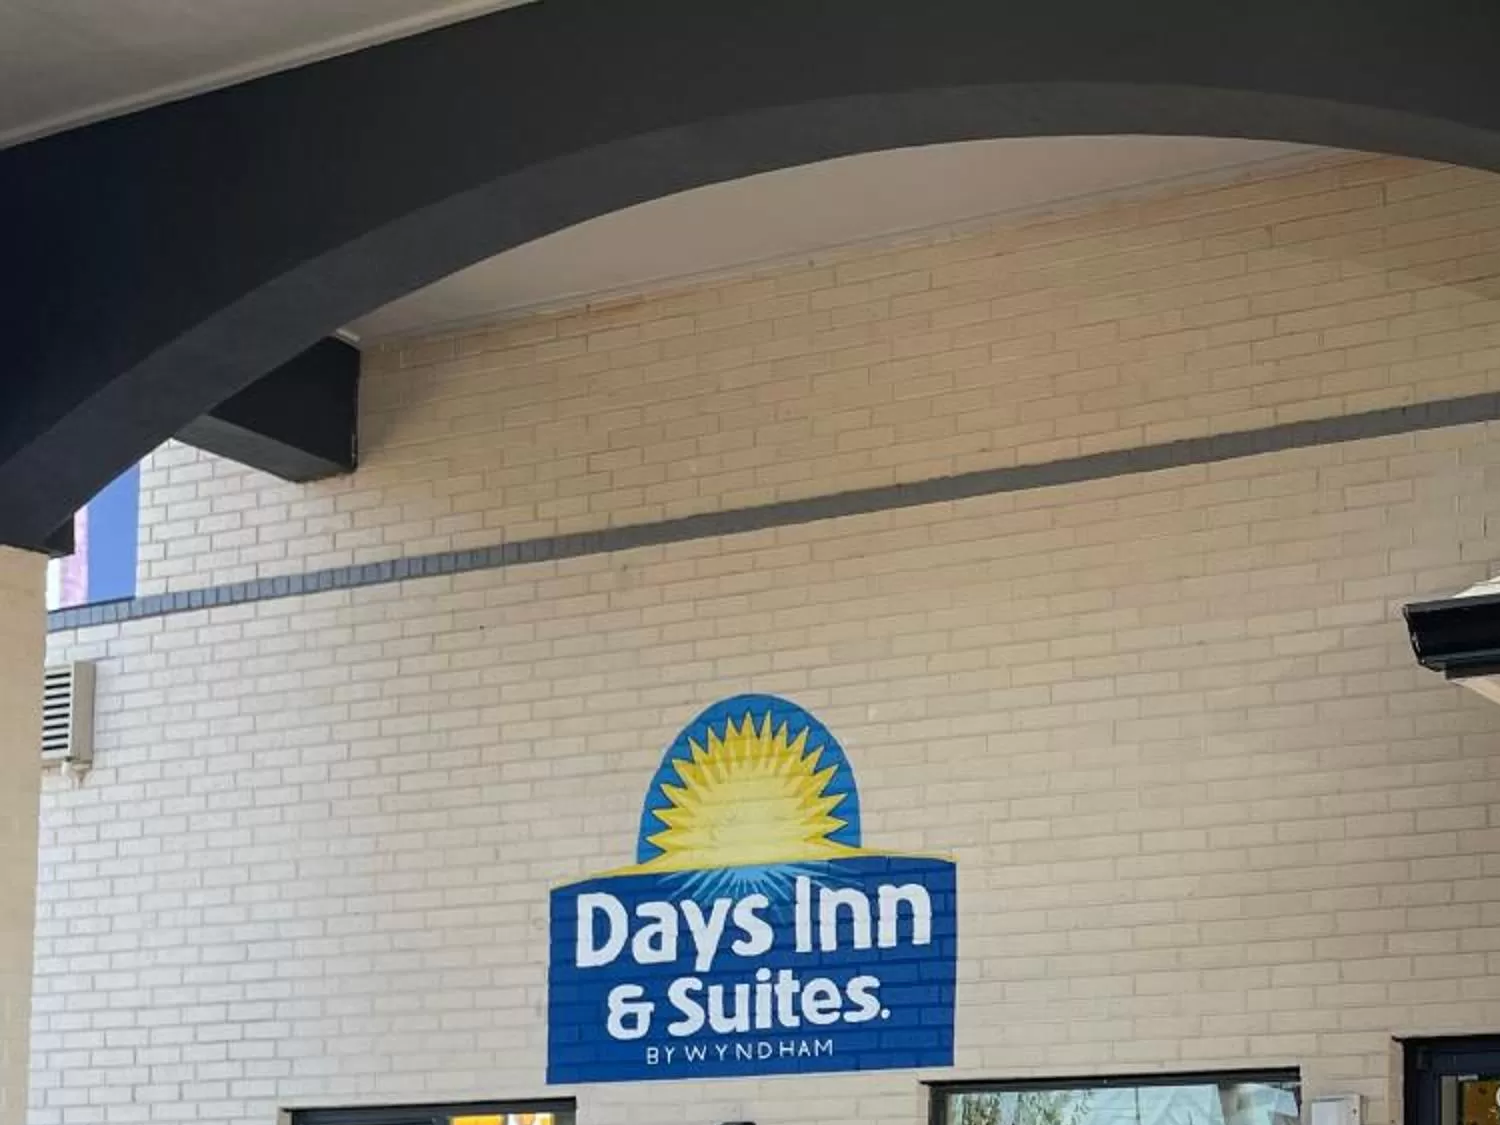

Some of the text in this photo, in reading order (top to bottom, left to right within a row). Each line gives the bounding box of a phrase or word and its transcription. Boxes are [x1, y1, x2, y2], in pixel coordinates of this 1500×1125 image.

[575, 875, 932, 973] Days Inn
[607, 984, 655, 1040] &
[646, 1038, 834, 1065] BY WYNDHAM
